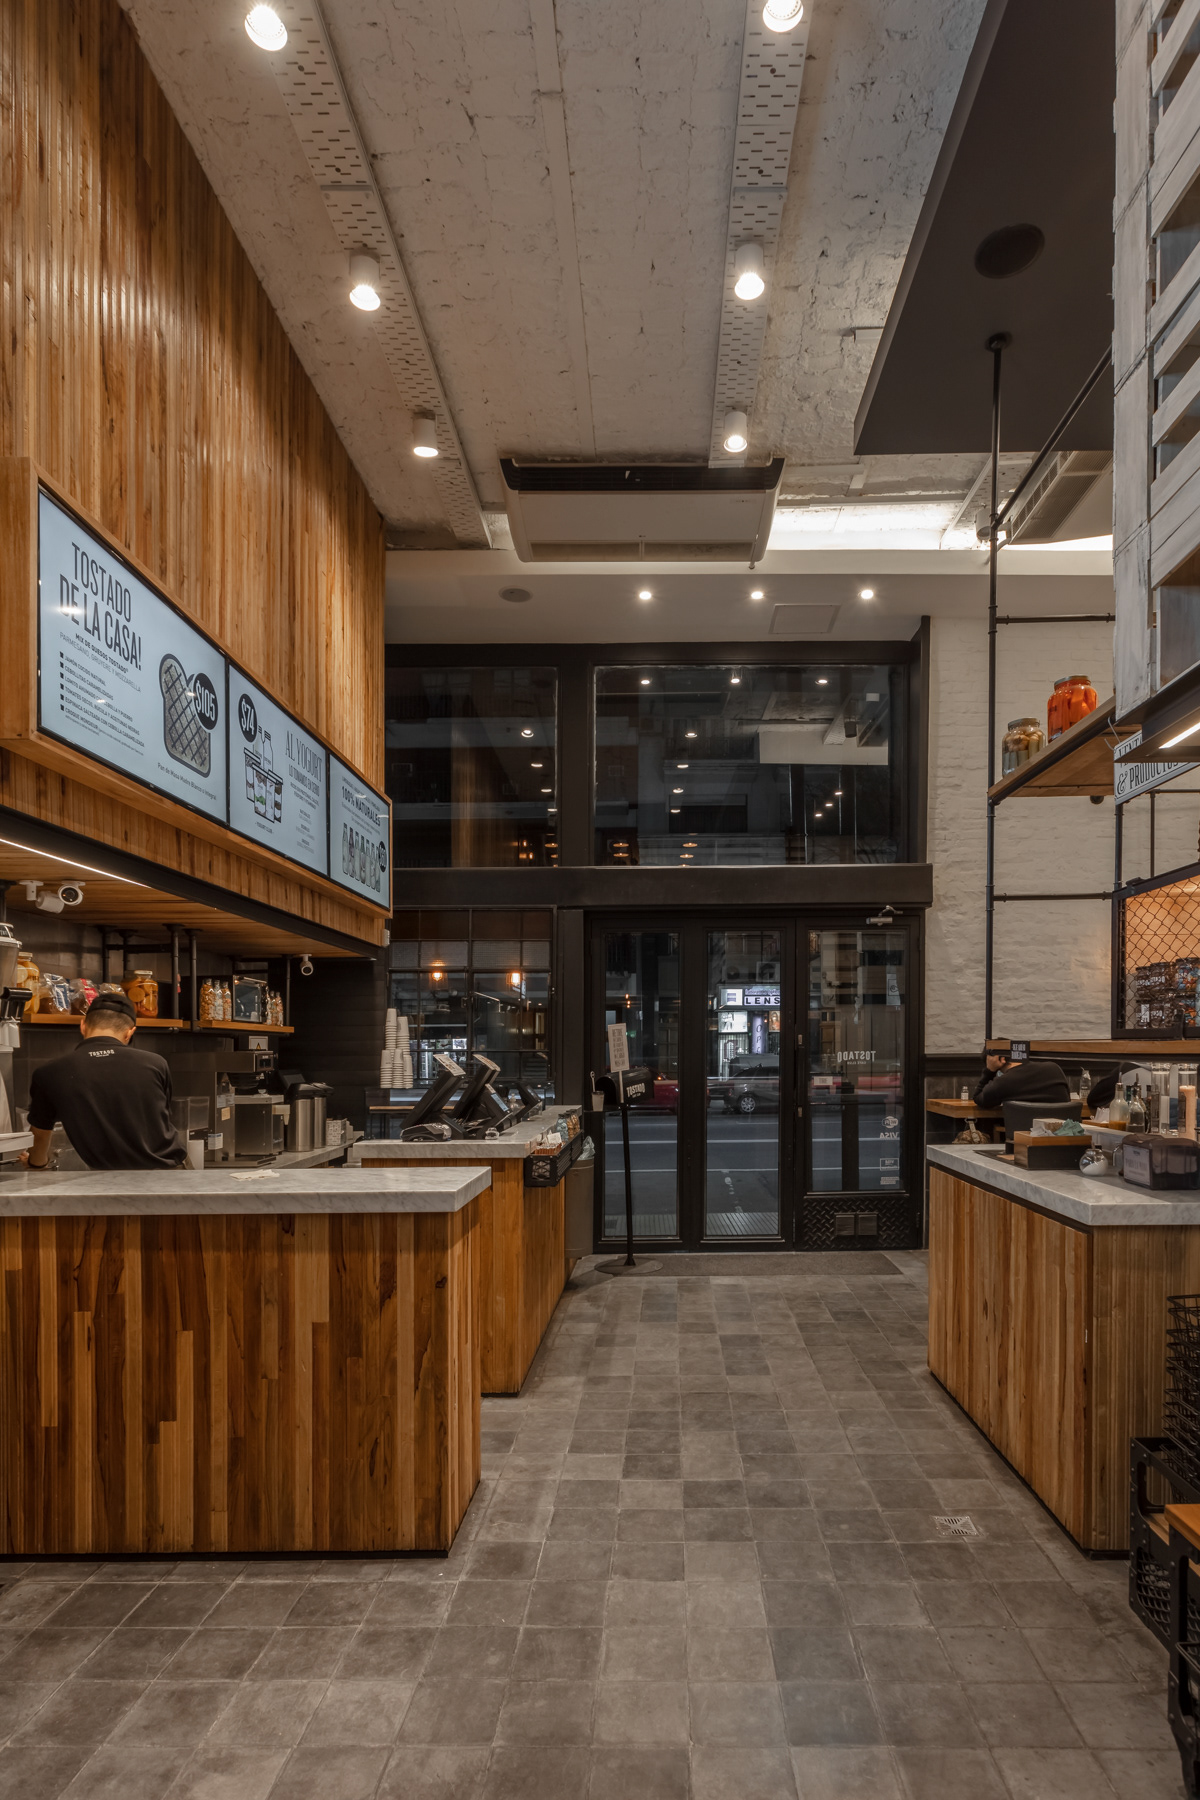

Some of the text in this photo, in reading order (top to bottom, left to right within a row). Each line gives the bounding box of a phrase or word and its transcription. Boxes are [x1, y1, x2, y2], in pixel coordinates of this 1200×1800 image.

[71, 541, 131, 622] TOSTADO
[60, 573, 141, 671] DE LA CASA!
[75, 632, 83, 644] MIX
[84, 639, 90, 648] DE
[91, 643, 107, 661] QUESOS
[195, 680, 216, 722] $105
[241, 698, 255, 736] $74
[284, 730, 323, 782] AL YOGURT
[1117, 762, 1178, 795] & PRODUC
[342, 785, 355, 807] 100%
[355, 797, 380, 827] NATURALES
[88, 1049, 115, 1057] TOSTADO
[626, 1082, 646, 1098] TOSTADO
